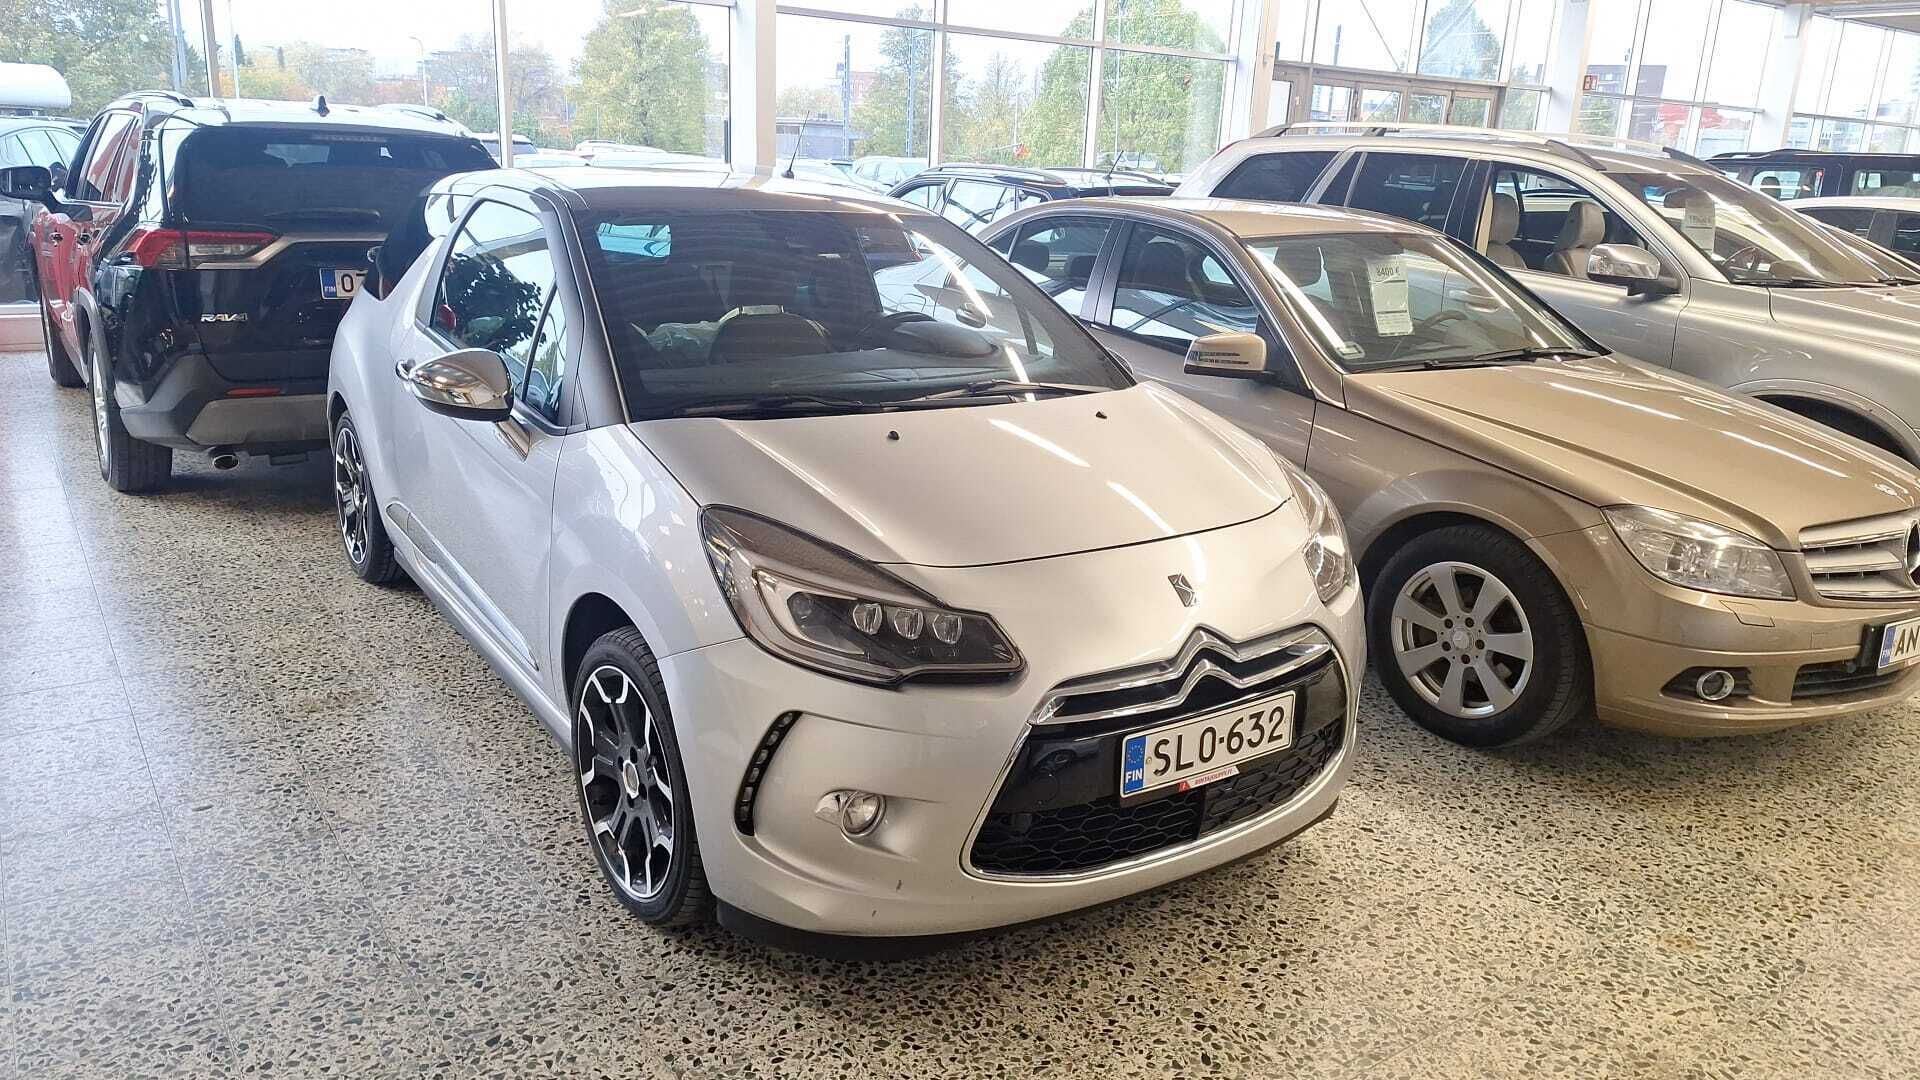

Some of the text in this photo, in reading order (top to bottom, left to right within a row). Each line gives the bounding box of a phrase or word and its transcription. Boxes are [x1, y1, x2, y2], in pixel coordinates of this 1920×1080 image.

[201, 312, 248, 322] RAV4
[1153, 705, 1285, 776] SLO-632
[1125, 767, 1143, 784] FIN
